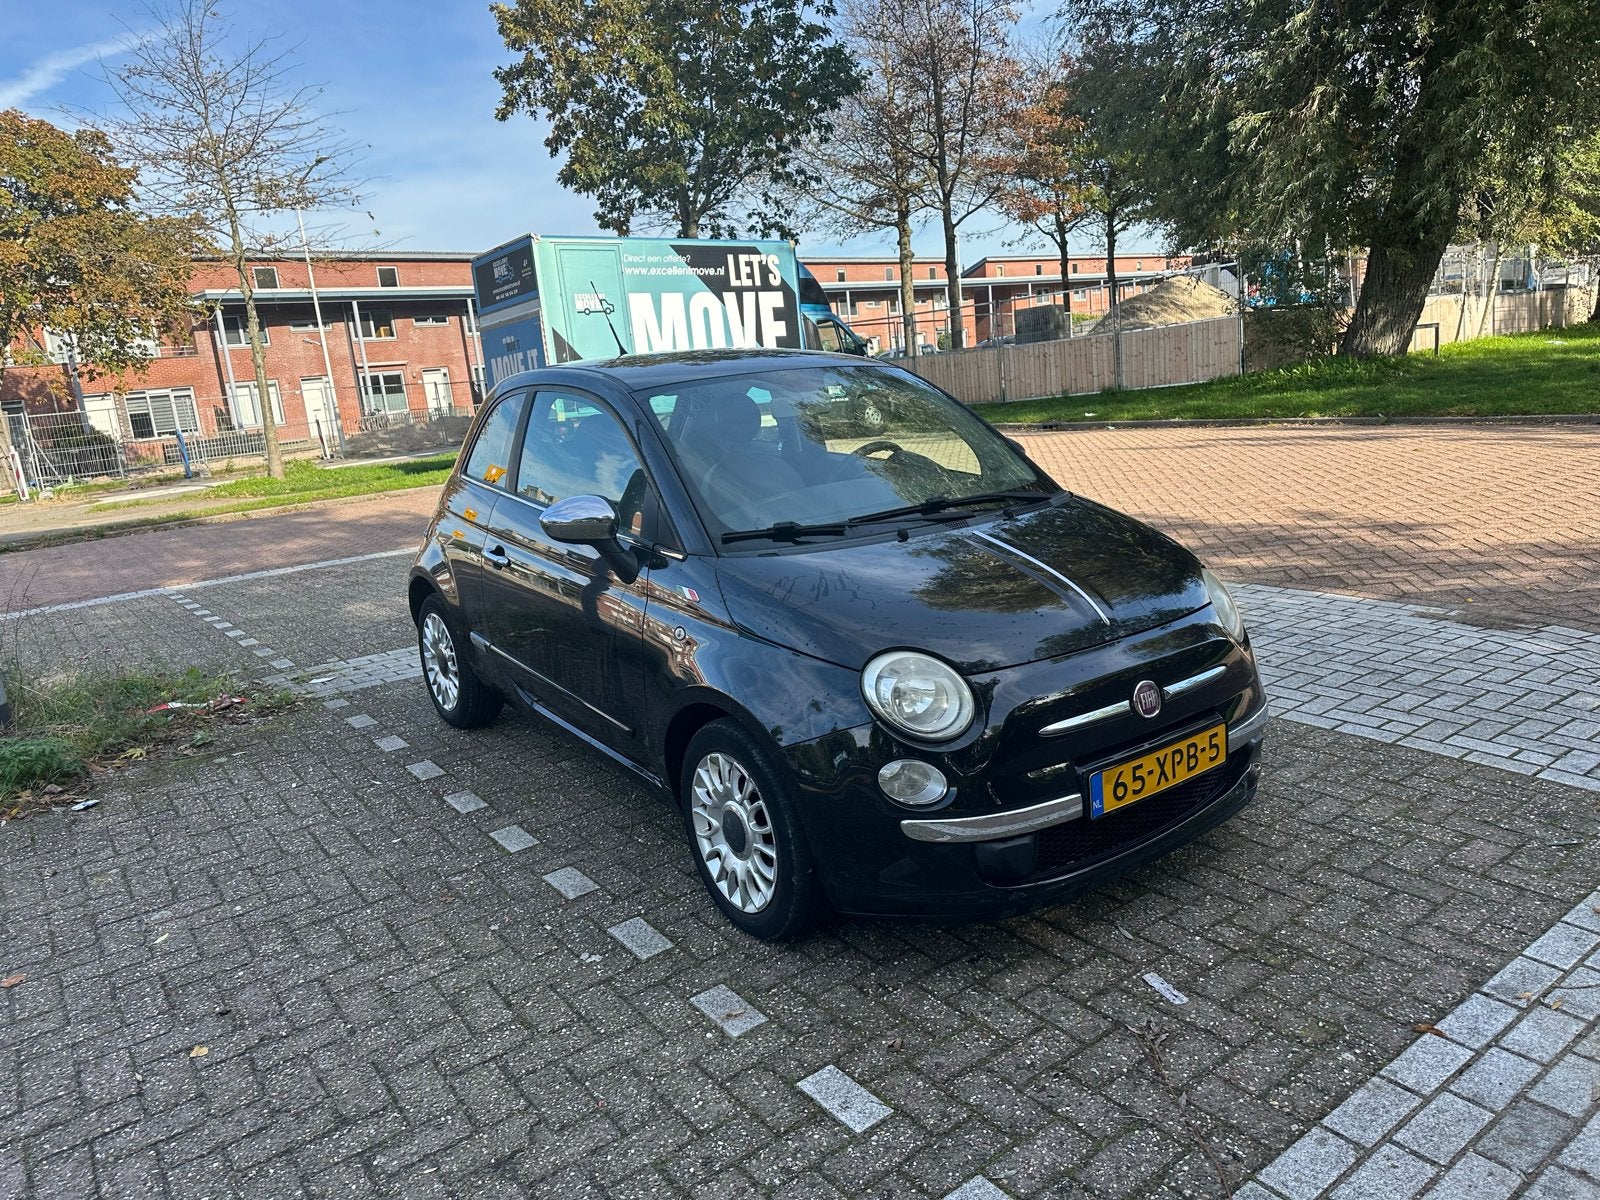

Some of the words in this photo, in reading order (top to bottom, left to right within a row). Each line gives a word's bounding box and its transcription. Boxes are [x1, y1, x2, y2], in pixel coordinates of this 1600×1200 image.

[623, 254, 645, 263] Direct
[647, 255, 662, 263] een
[663, 254, 691, 264] offerte?
[625, 265, 725, 276] www.excellentmove.nl
[628, 291, 787, 353] MOVE
[491, 352, 525, 383] MOVE
[527, 348, 539, 370] IT
[1140, 689, 1156, 710] FIAT
[1112, 732, 1220, 802] 65-XPB-5
[1093, 799, 1102, 810] NL
